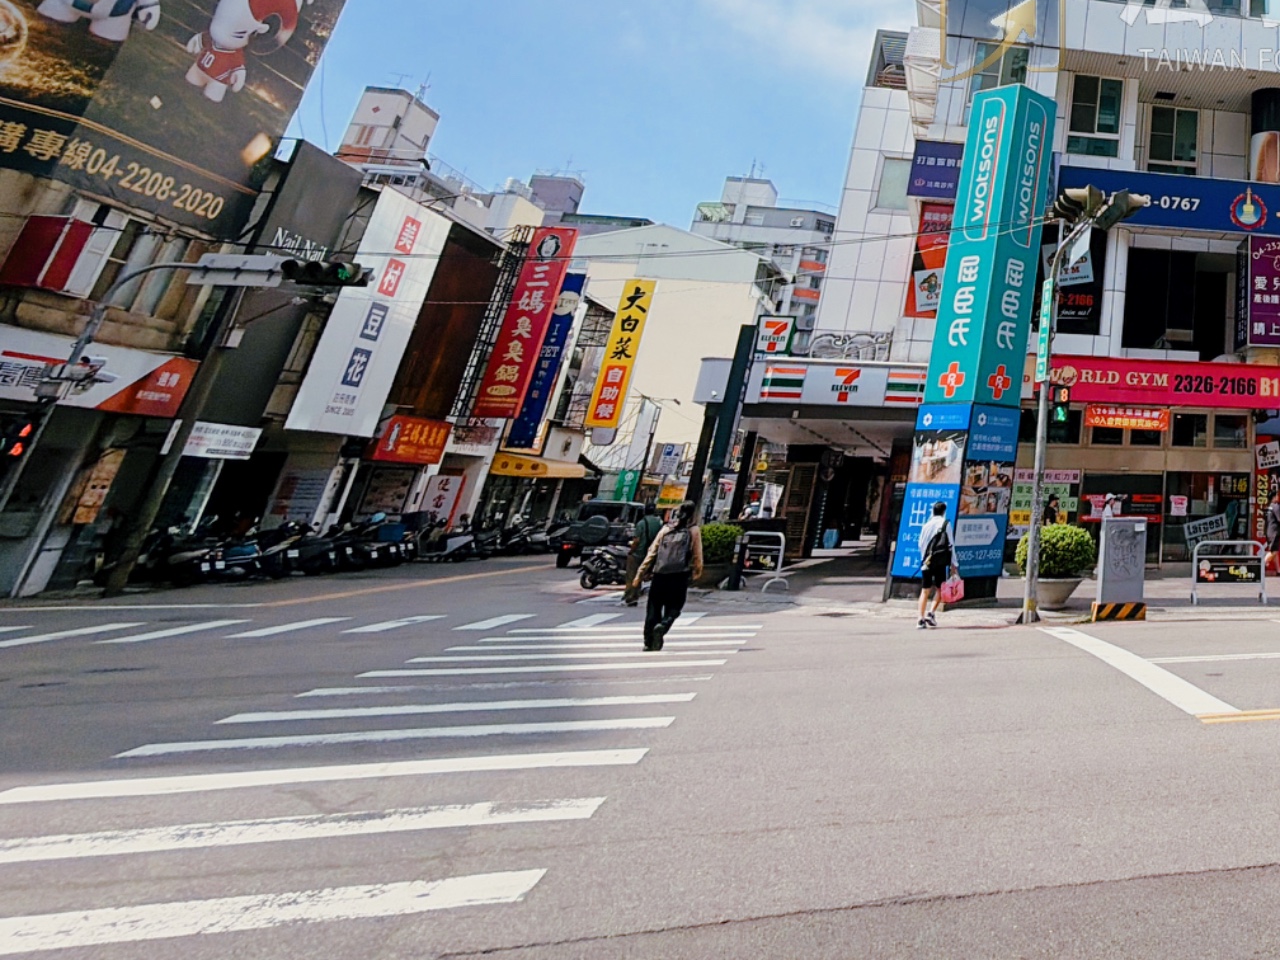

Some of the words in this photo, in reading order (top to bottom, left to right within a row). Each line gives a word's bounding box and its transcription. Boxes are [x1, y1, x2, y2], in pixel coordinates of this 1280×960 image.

[201, 51, 216, 68] 10
[971, 116, 997, 222] watsons
[1017, 122, 1040, 225] watsons
[343, 218, 418, 385] 美村豆花
[494, 266, 549, 383] 三媽臭臭鍋
[609, 286, 647, 361] 大白菜
[949, 255, 979, 346] 屈臣氏
[997, 258, 1025, 349] 屈臣氏
[595, 368, 624, 419] 自助餐
[1060, 389, 1068, 402] 8
[1126, 371, 1169, 387] GYM
[1174, 373, 1257, 396] 2326-2166
[1259, 376, 1280, 397] B1
